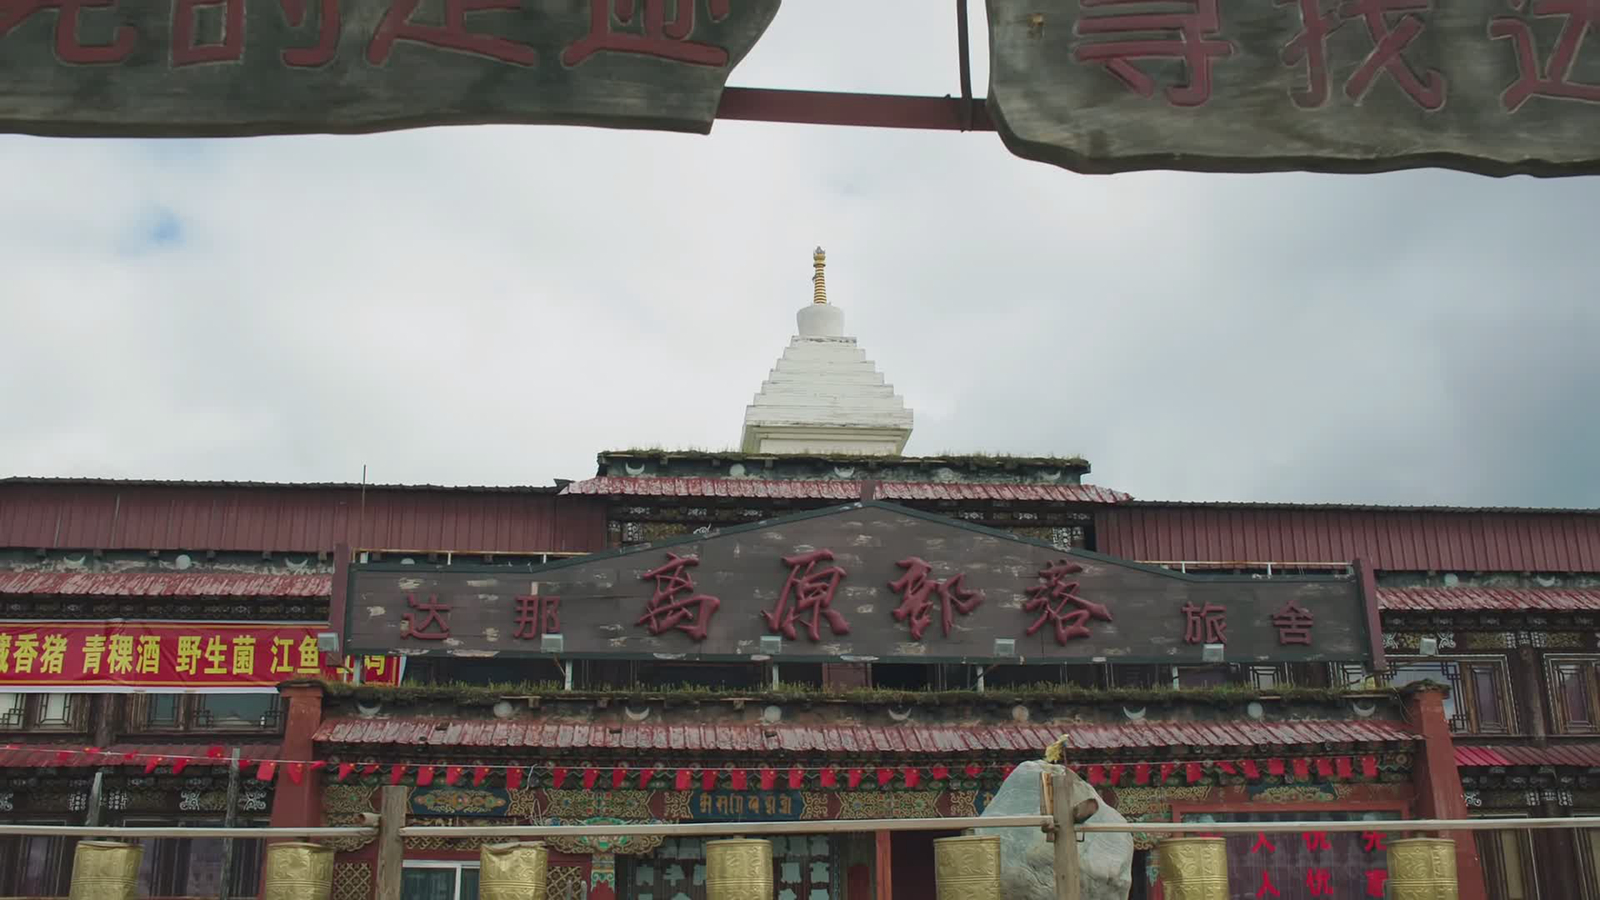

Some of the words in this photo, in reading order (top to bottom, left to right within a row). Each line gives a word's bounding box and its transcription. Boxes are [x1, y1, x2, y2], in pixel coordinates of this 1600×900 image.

[82, 634, 161, 675] 青稞酒
[175, 635, 256, 676] 野生菌
